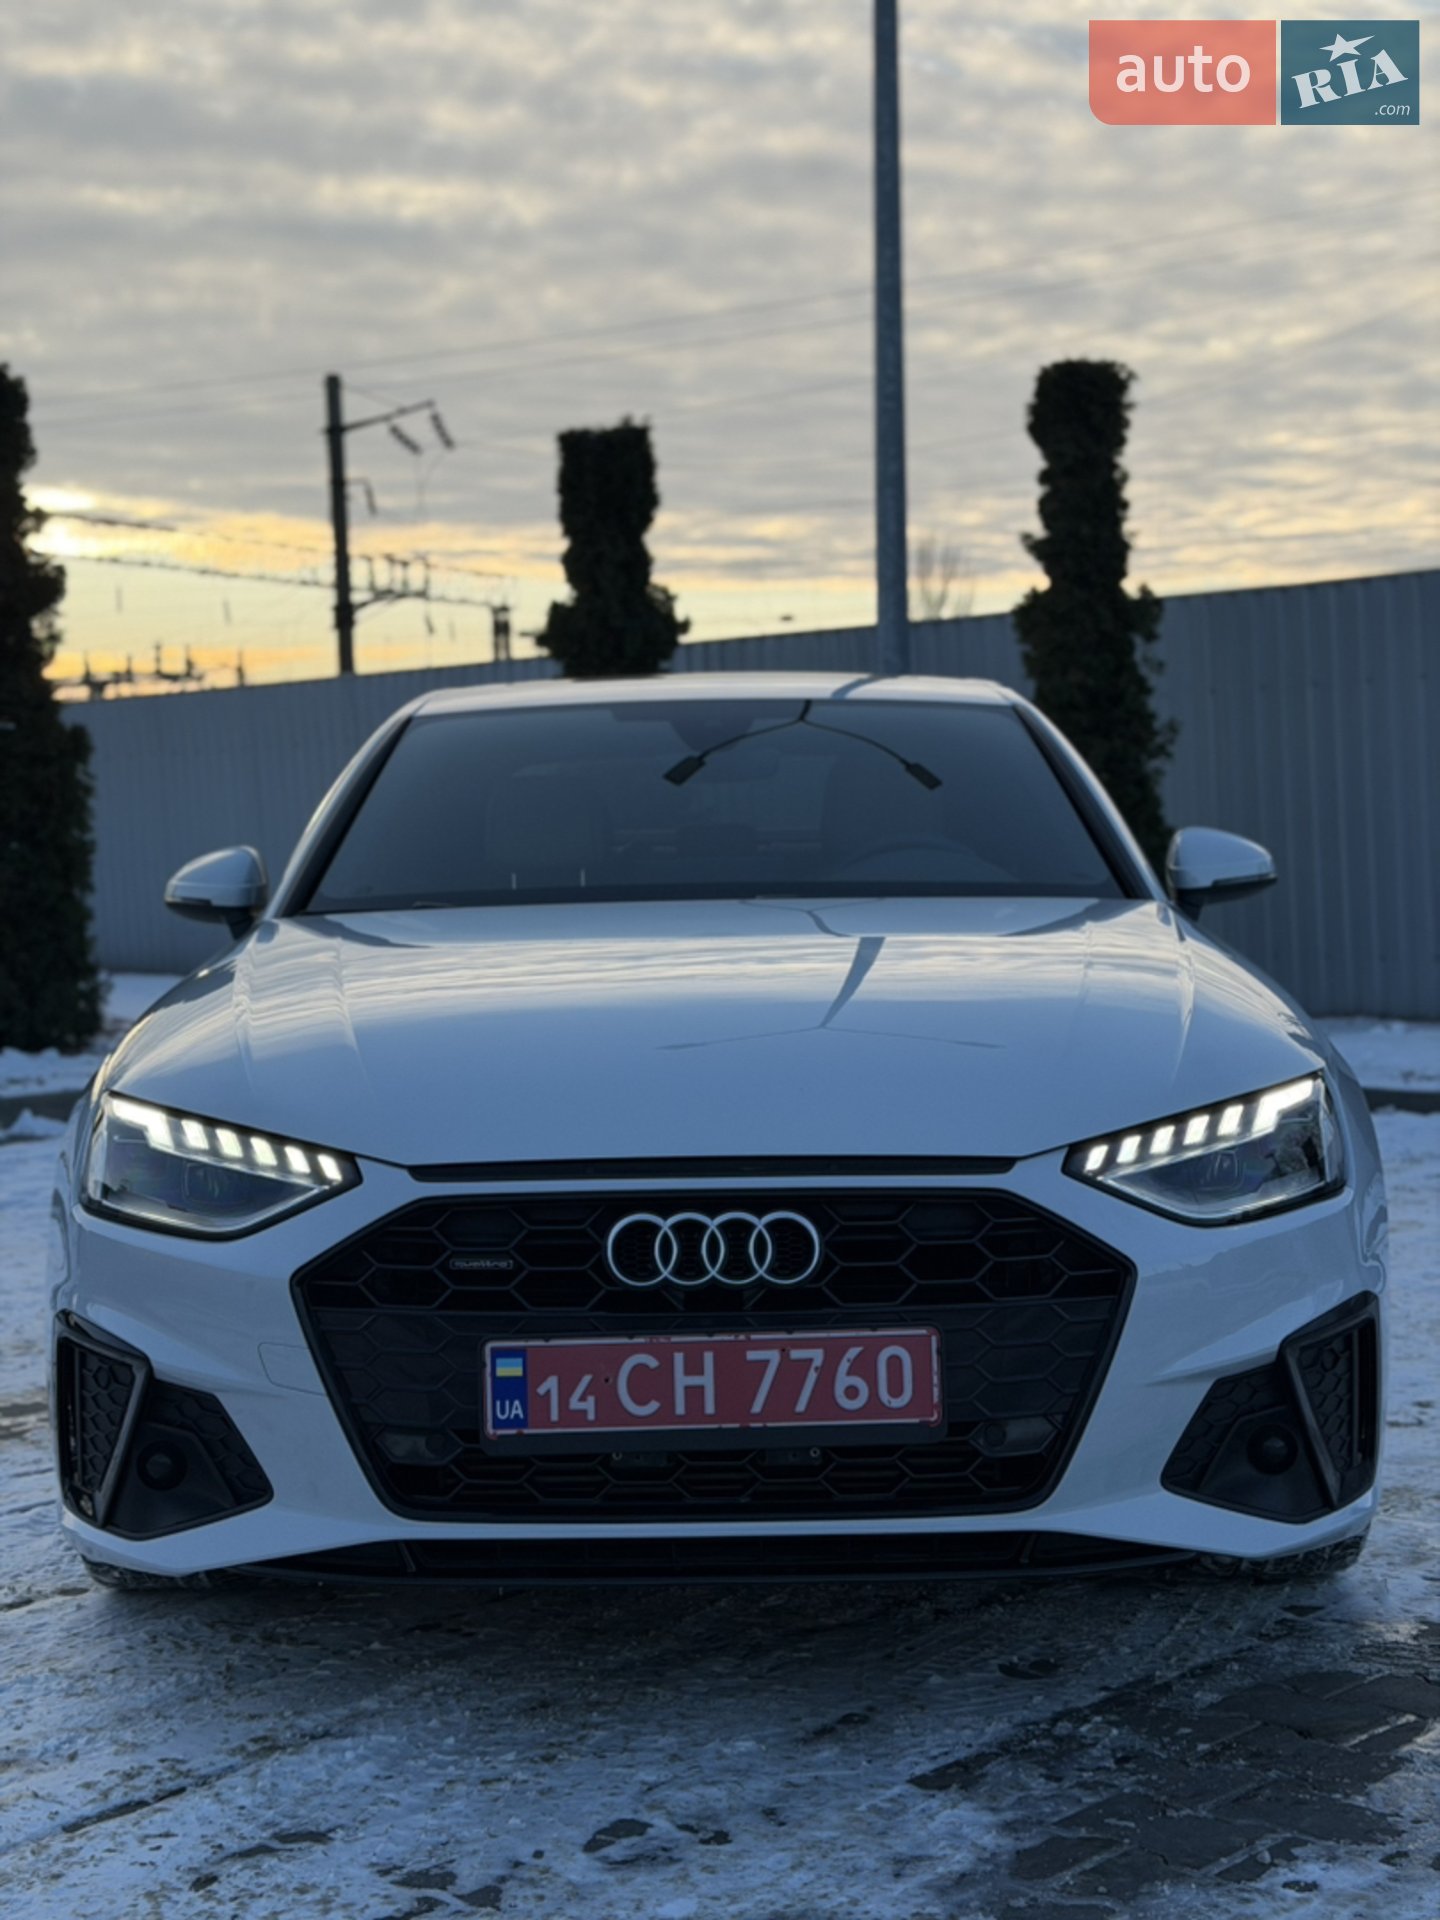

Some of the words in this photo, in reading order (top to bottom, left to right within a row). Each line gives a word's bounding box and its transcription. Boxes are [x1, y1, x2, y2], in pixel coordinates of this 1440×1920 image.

[536, 1374, 596, 1422] 14
[616, 1351, 716, 1417] CH
[745, 1345, 913, 1415] 7760
[495, 1399, 524, 1420] UA
